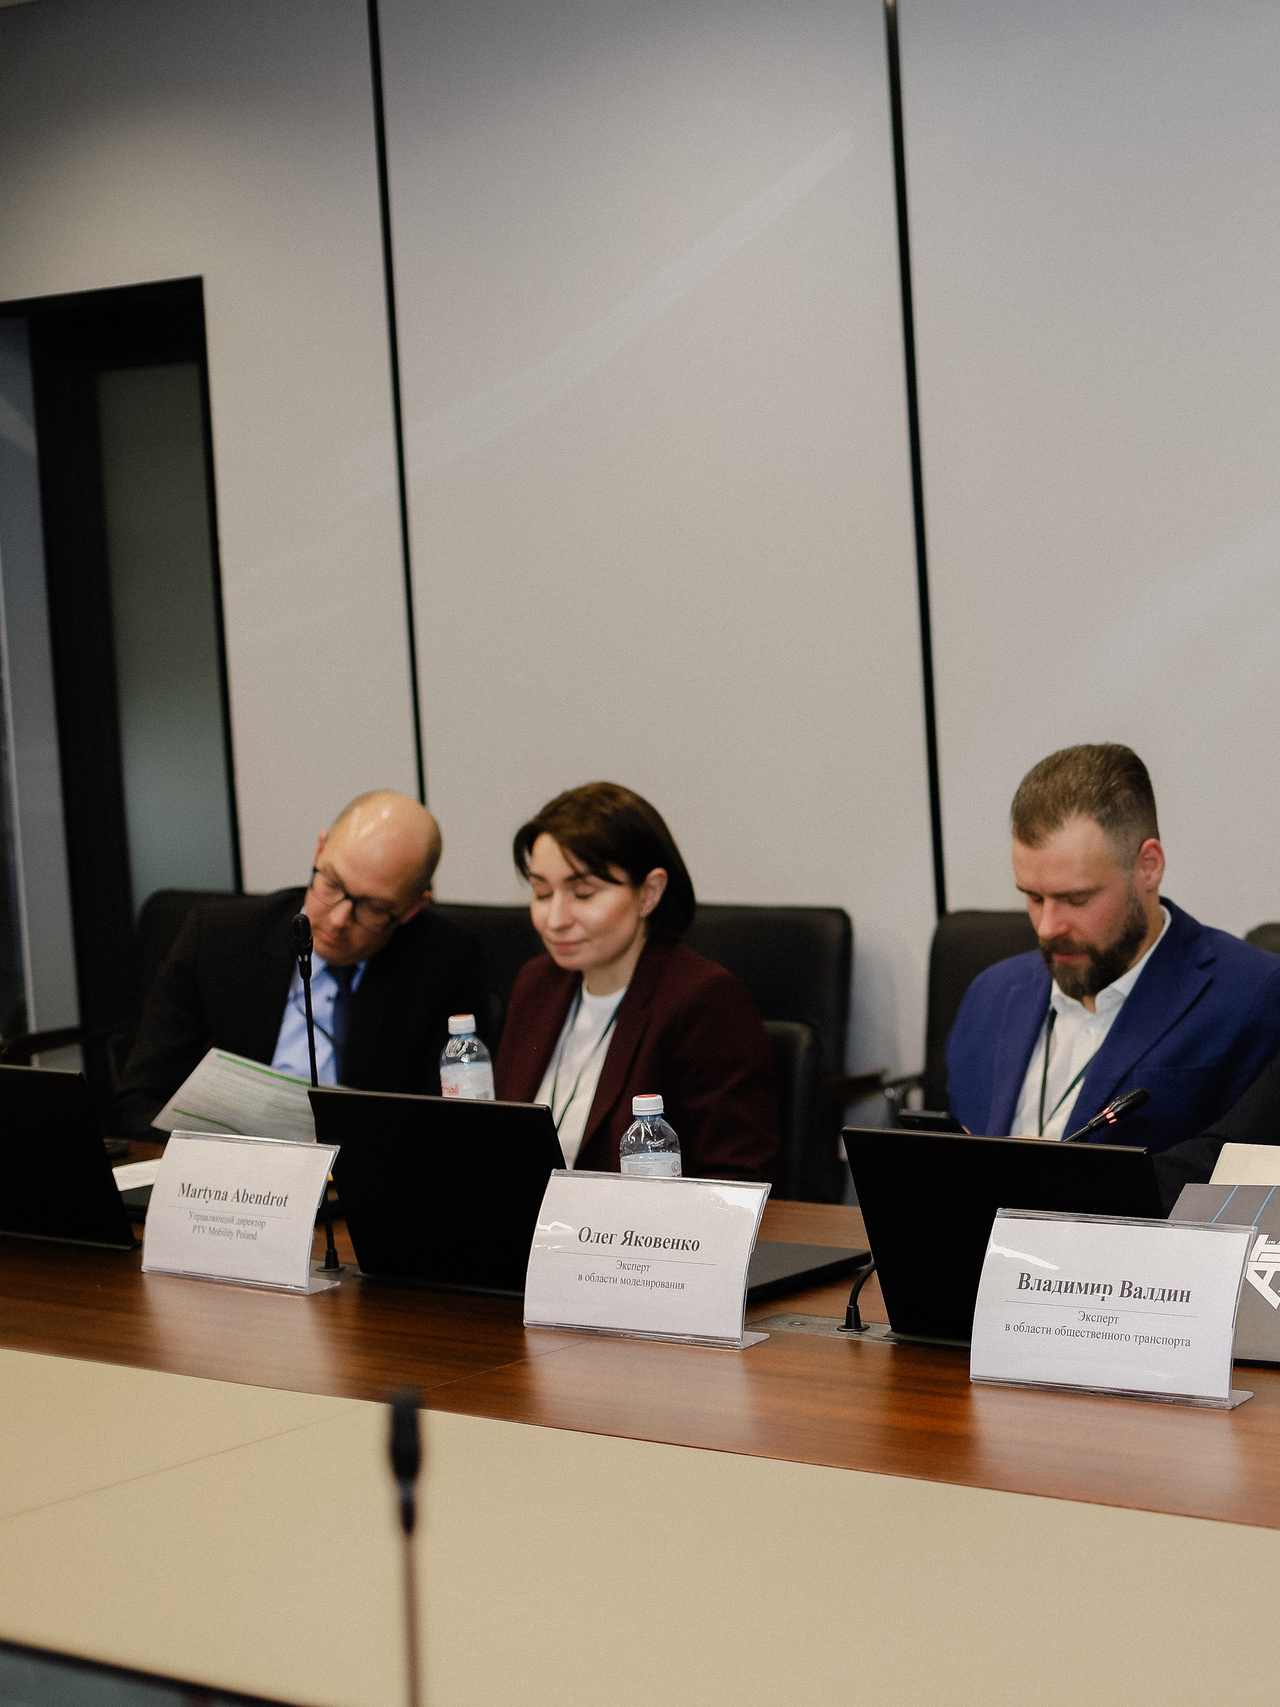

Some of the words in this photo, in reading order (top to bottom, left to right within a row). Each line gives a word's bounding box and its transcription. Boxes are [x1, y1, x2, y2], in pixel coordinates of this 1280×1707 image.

[177, 1182, 228, 1204] Martyna
[230, 1188, 289, 1207] Abendrot
[189, 1210, 235, 1224] Управляющий
[235, 1217, 266, 1229] директор
[192, 1224, 207, 1234] PTV
[208, 1225, 234, 1240] Mobility
[235, 1229, 258, 1240] Poland
[578, 1226, 617, 1245] Олег
[620, 1230, 700, 1252] Яковенко
[616, 1259, 651, 1274] Эксперт
[577, 1273, 583, 1281] в
[584, 1272, 618, 1284] области
[619, 1277, 685, 1290] моделирования
[1016, 1271, 1114, 1302] Владимир
[1118, 1279, 1192, 1304] Валдин
[1077, 1310, 1120, 1327] Эксперт
[1004, 1323, 1011, 1332] в
[1012, 1321, 1052, 1336] области
[1054, 1325, 1131, 1342] общественного
[1132, 1333, 1192, 1349] транспорта
